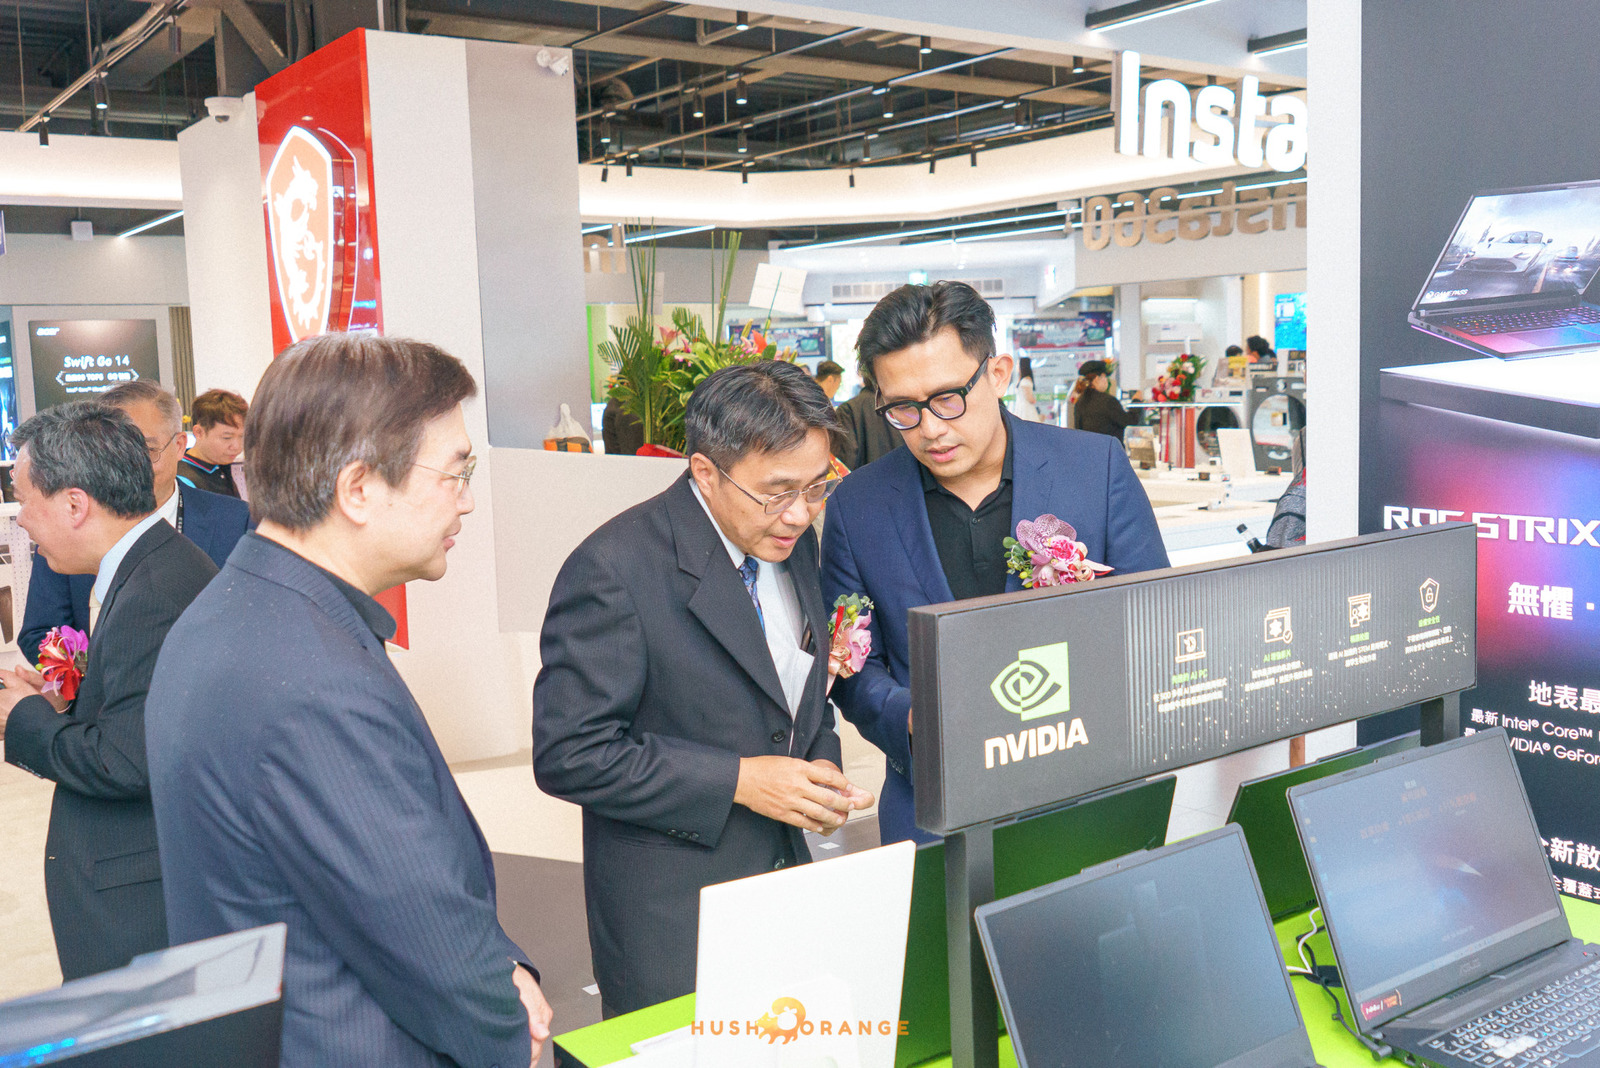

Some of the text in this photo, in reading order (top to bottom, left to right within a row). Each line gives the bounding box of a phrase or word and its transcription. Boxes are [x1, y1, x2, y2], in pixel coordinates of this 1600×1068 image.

[1116, 50, 1307, 172] Insta
[64, 354, 130, 370] Swift Go 14
[1472, 512, 1600, 547] STRIX
[1528, 680, 1600, 714] 地表最
[1471, 708, 1593, 740] 最新 Intel® Core™
[984, 717, 1089, 769] NVIDIA
